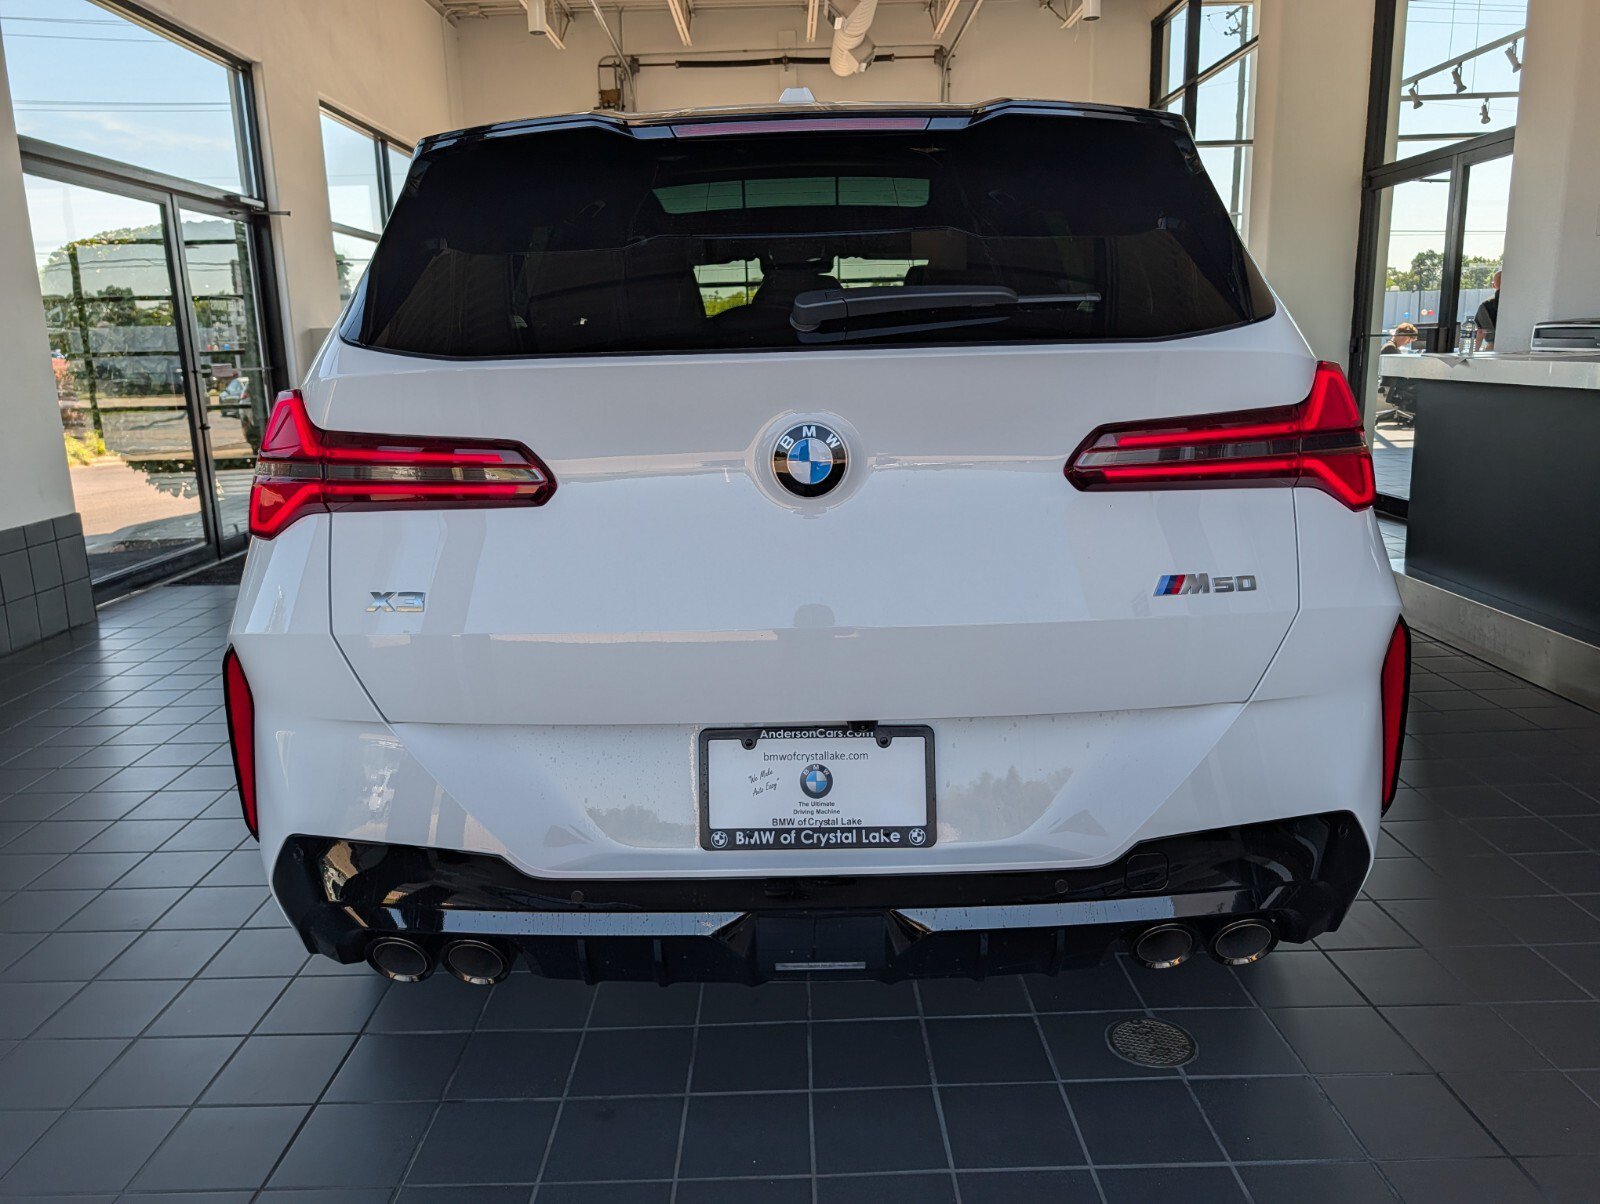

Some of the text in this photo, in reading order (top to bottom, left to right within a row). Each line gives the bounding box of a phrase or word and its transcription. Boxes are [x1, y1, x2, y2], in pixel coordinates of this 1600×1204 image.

[780, 425, 841, 450] BMW
[365, 591, 426, 612] X3
[760, 729, 874, 739] AndersonCars.com
[763, 751, 869, 763] bmwofcrystallake.com
[771, 817, 863, 828] BMW of Crystal Lake
[735, 828, 901, 847] BMW of Crystal Lake
